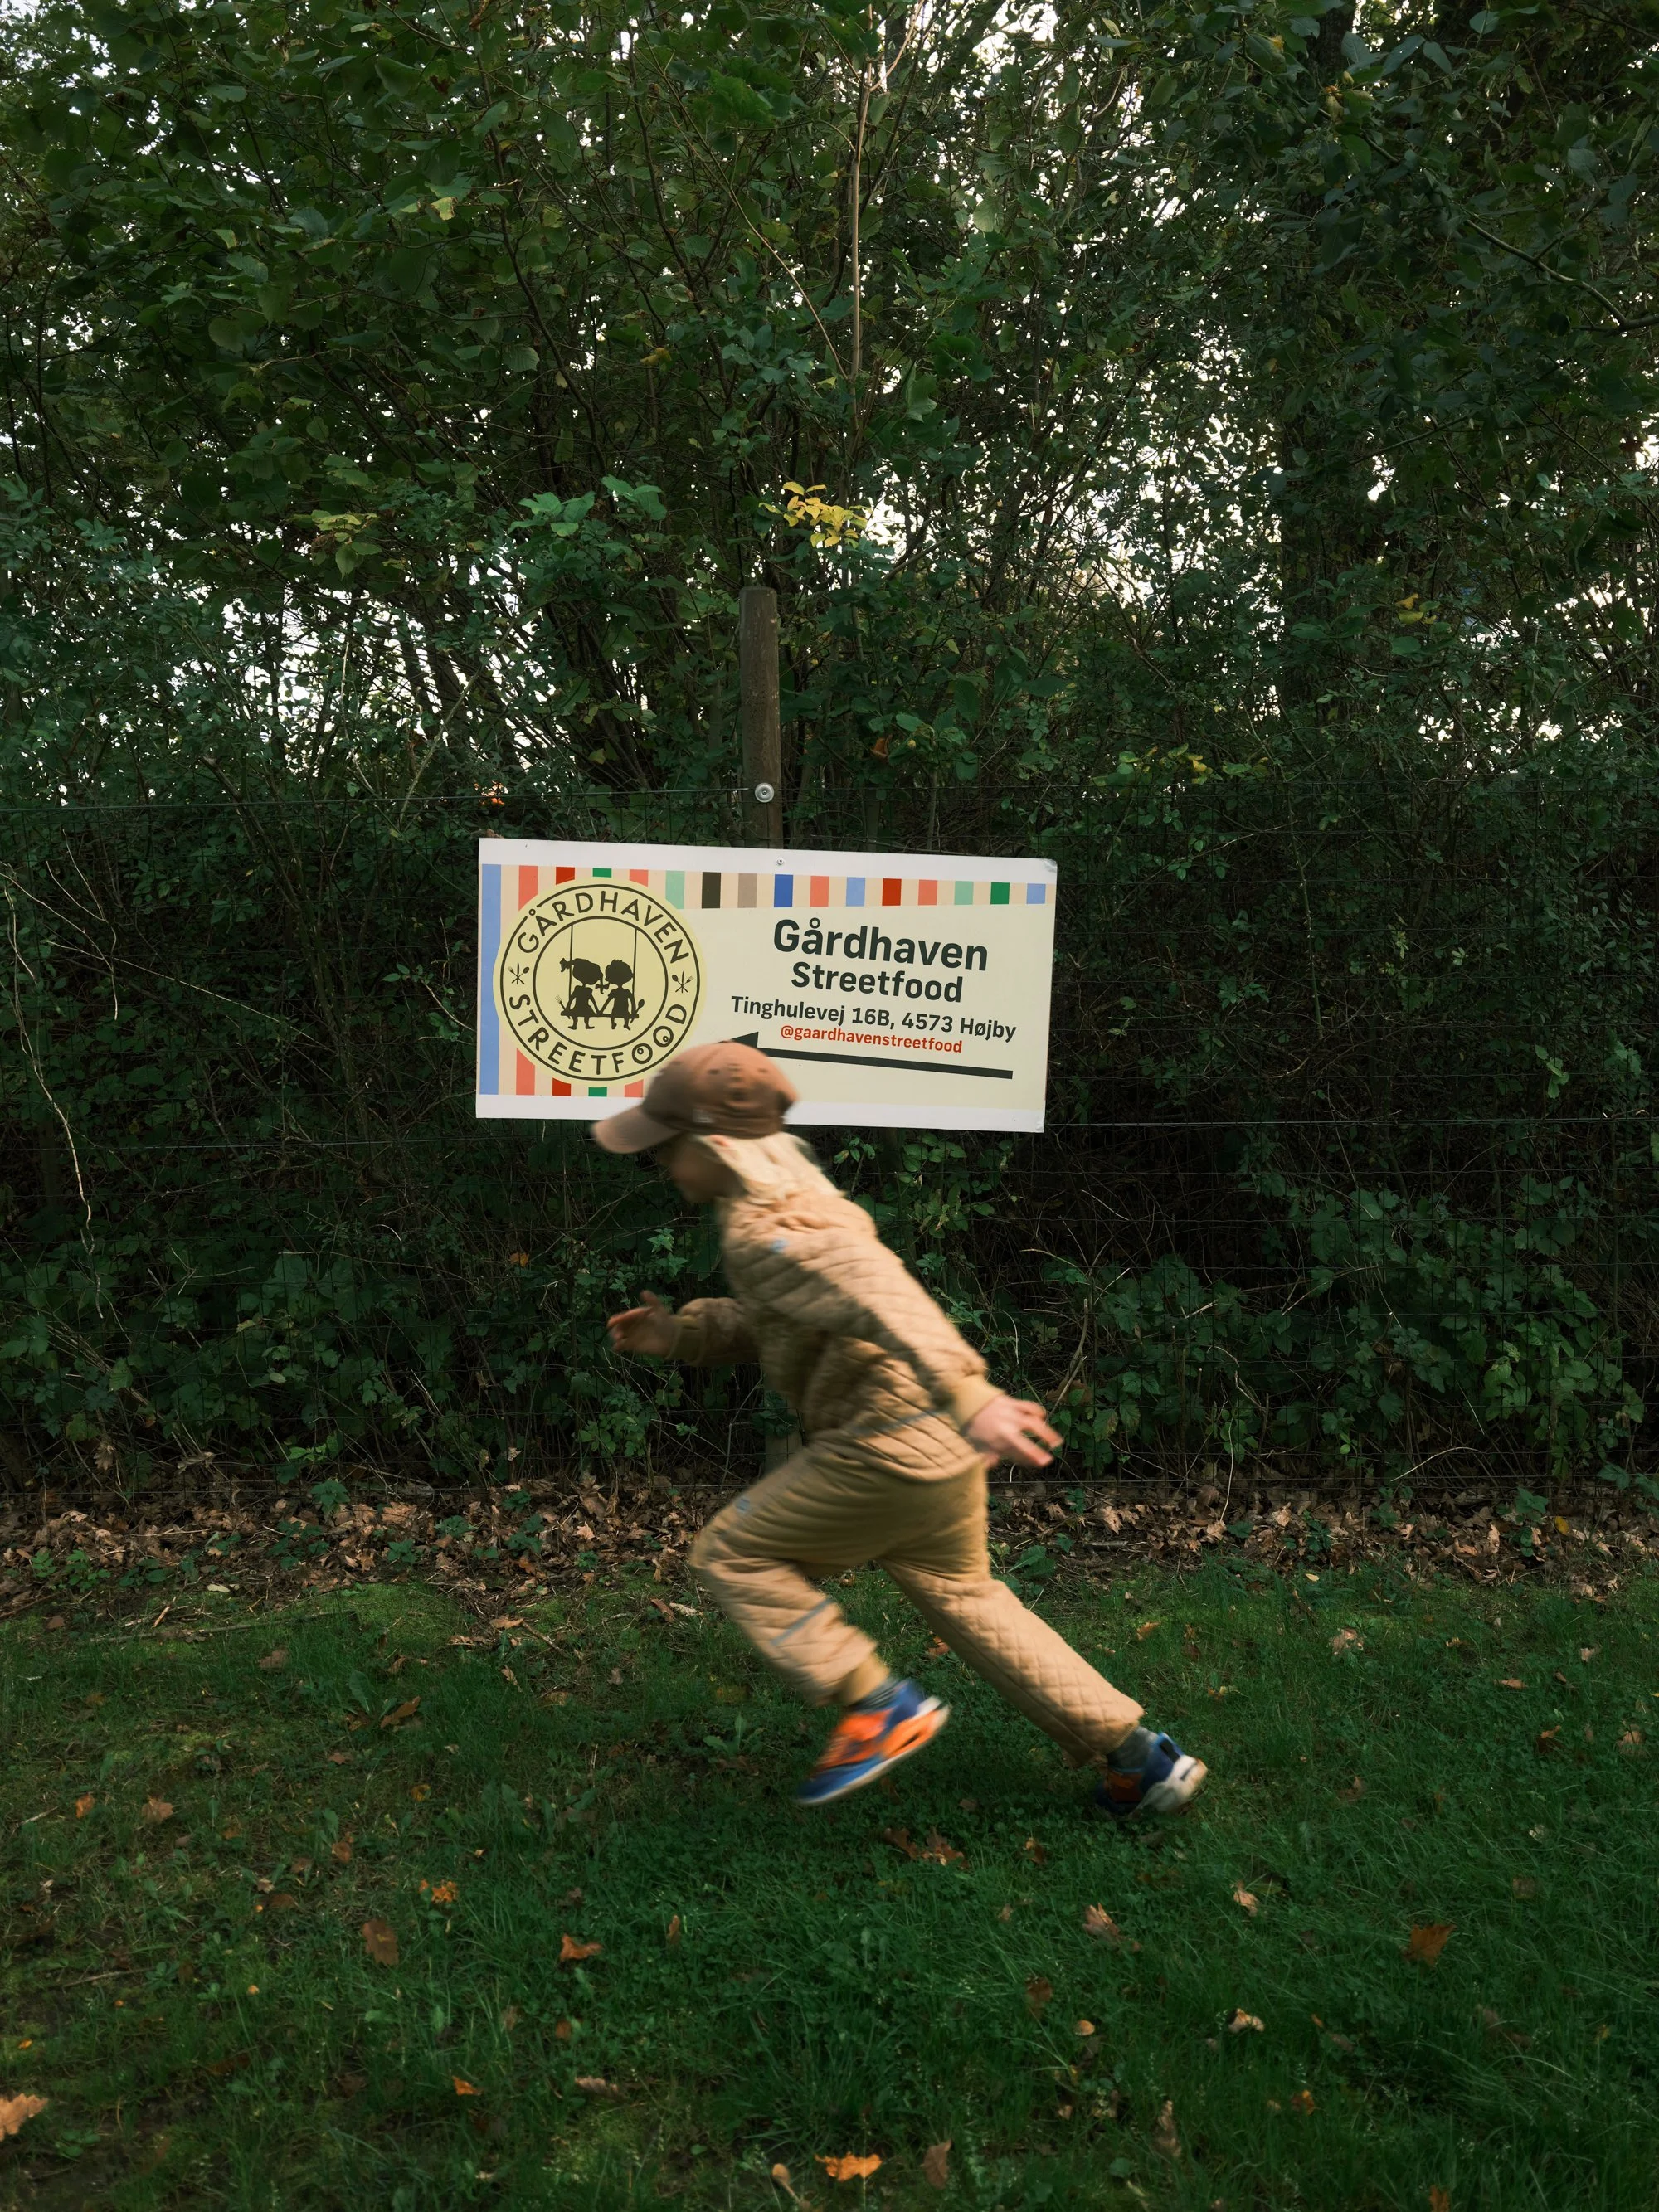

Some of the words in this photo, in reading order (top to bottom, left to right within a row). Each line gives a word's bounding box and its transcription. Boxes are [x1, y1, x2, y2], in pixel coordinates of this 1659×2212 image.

[517, 890, 689, 964] GÅRDHAVEN
[773, 917, 988, 971] Gårdhaven
[791, 960, 963, 1003] Streetfood
[508, 994, 688, 1076] STREETFOOD
[731, 995, 846, 1026] Tinghulevej
[851, 1006, 895, 1030] 16B,
[901, 1011, 953, 1033] 4573
[959, 1017, 1018, 1043] Højby
[780, 1025, 963, 1053] @gaardhavenstreetfood
